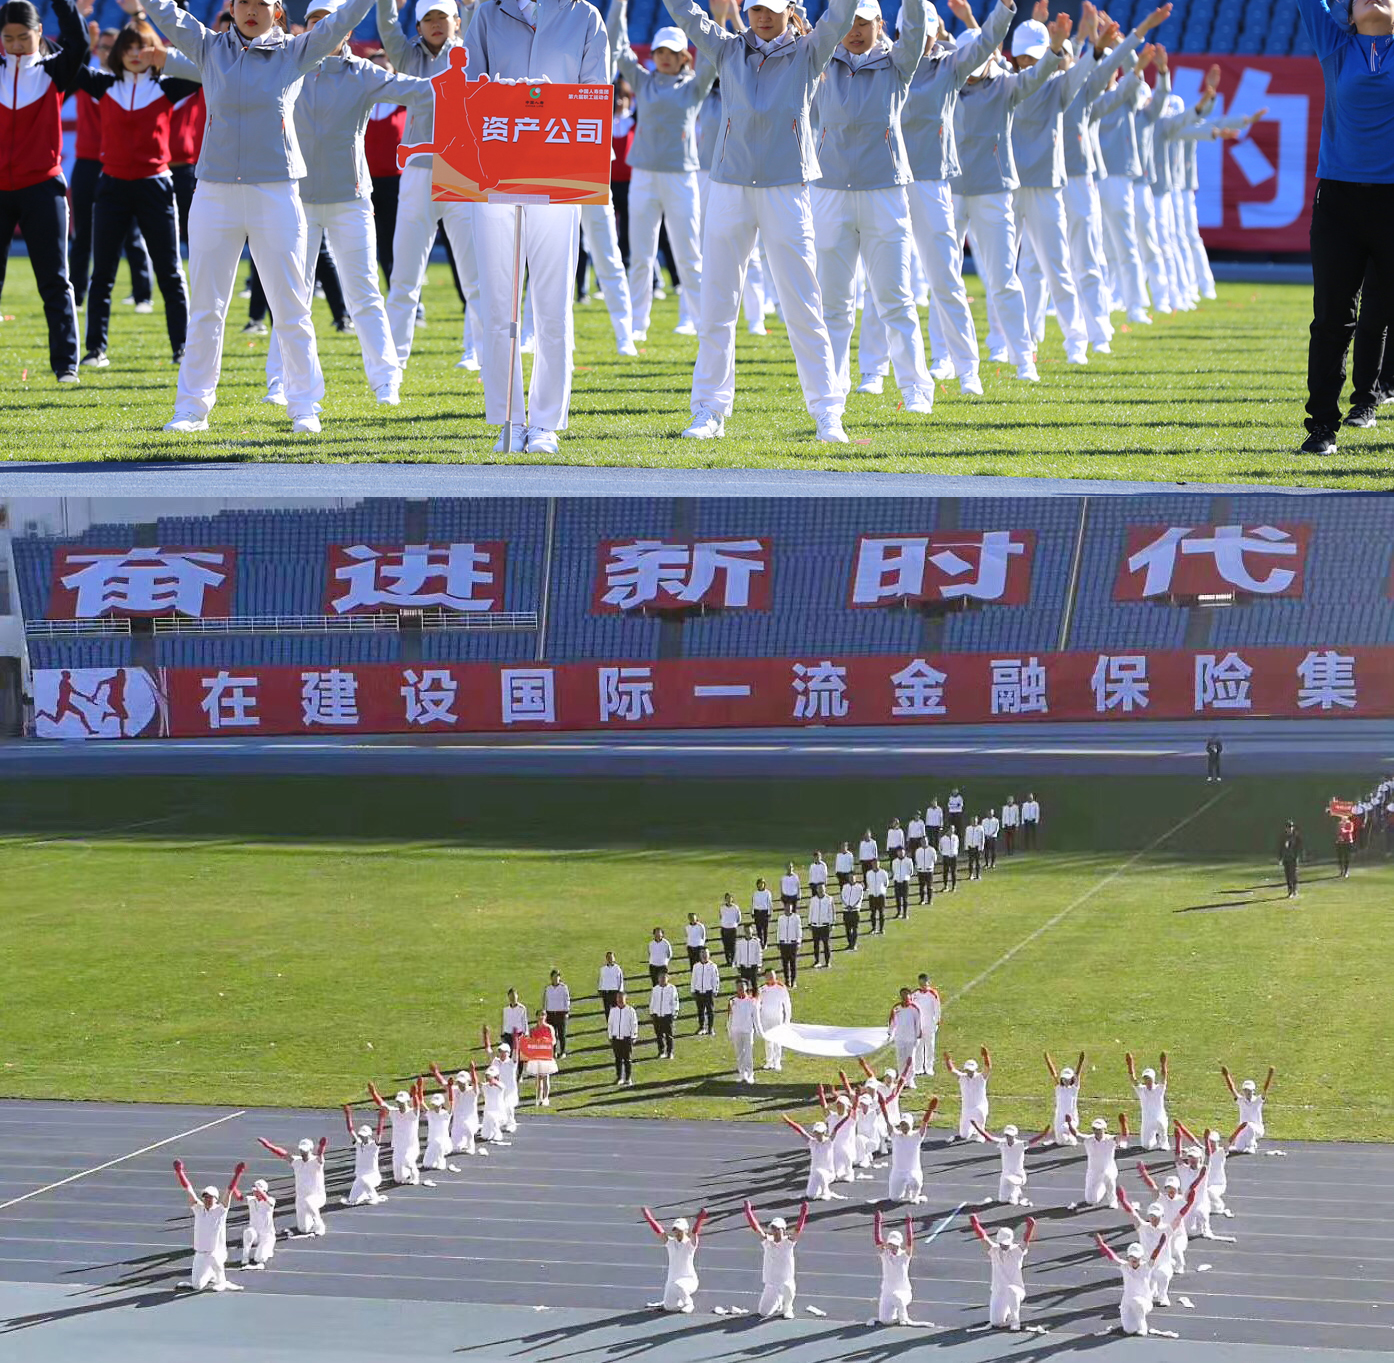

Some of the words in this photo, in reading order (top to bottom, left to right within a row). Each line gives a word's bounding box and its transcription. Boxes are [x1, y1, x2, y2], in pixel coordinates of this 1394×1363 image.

[482, 116, 604, 145] 资产公司
[201, 650, 1358, 727] 在建设国际一流金融保险集
